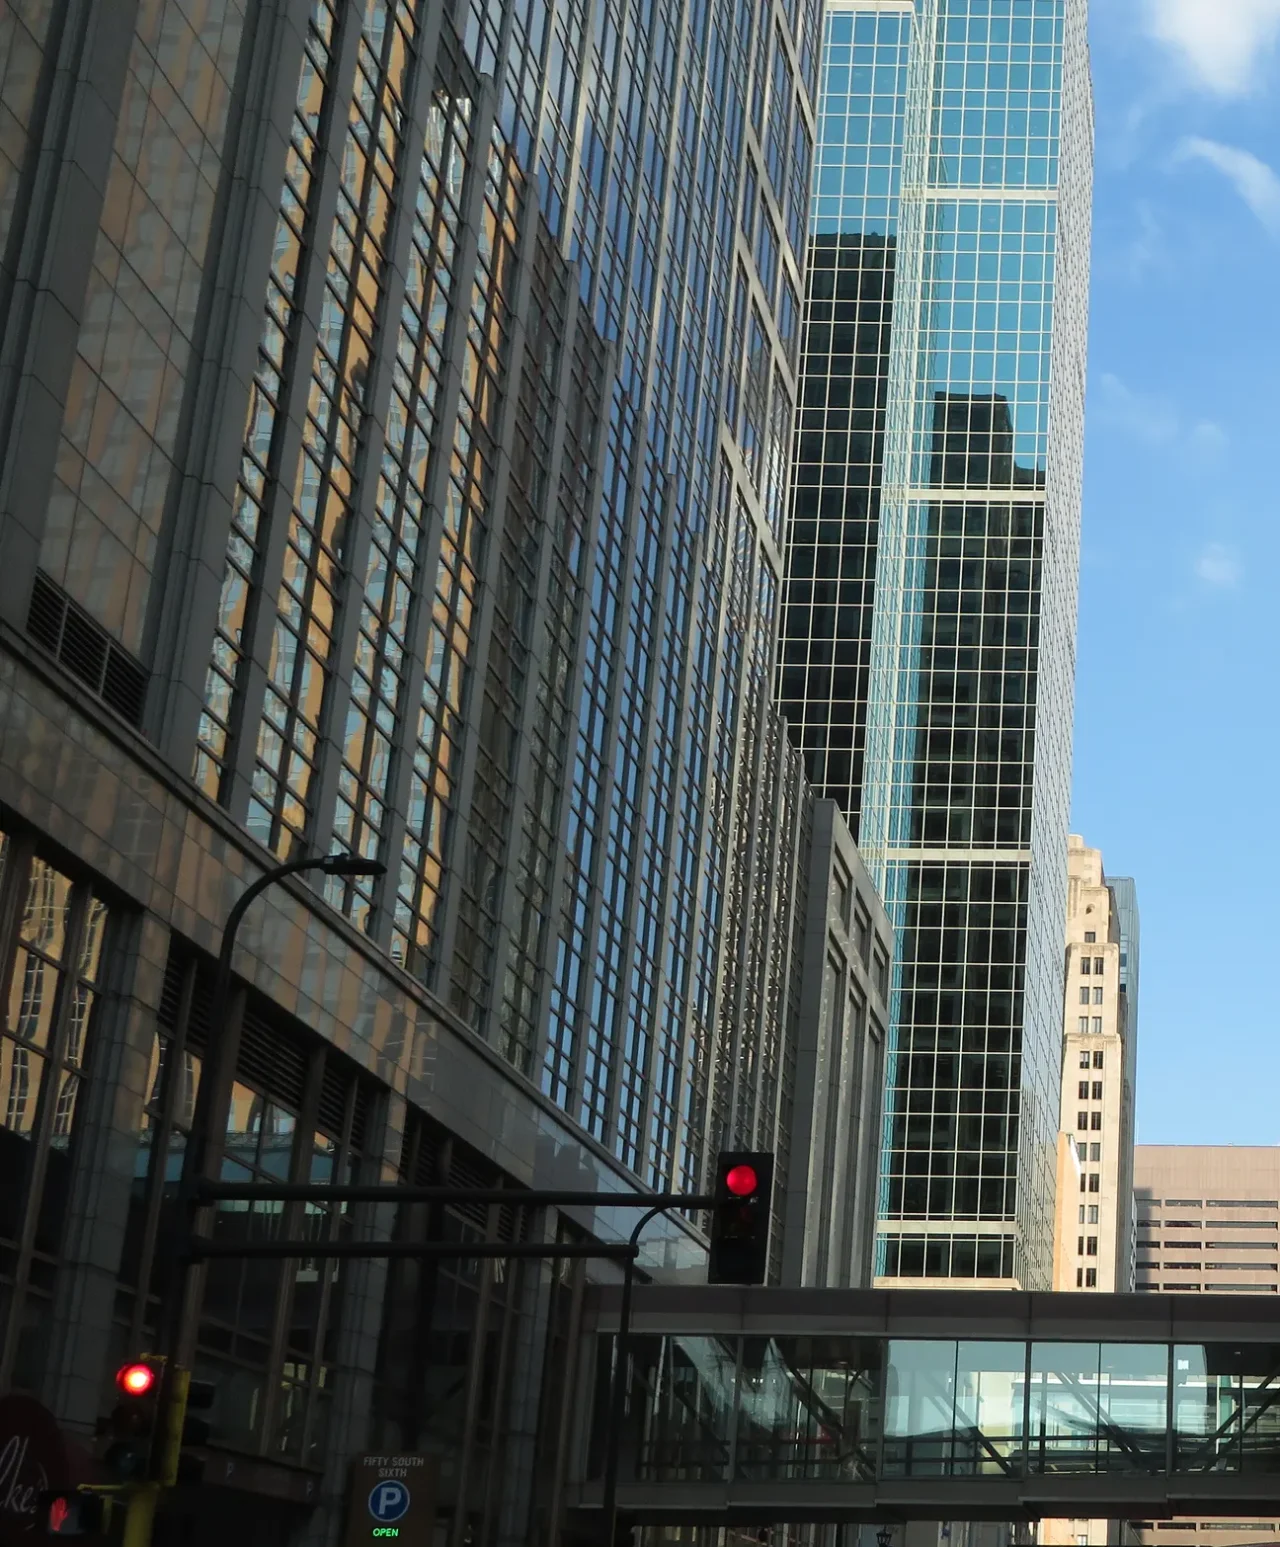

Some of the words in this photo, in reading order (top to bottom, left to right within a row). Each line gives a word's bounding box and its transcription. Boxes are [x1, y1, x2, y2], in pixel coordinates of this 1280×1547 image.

[363, 1456, 389, 1467] FIFTY
[391, 1456, 424, 1467] SOUTH
[378, 1468, 407, 1478] SIXTH
[378, 1487, 402, 1515] P
[372, 1528, 399, 1537] OPEN
